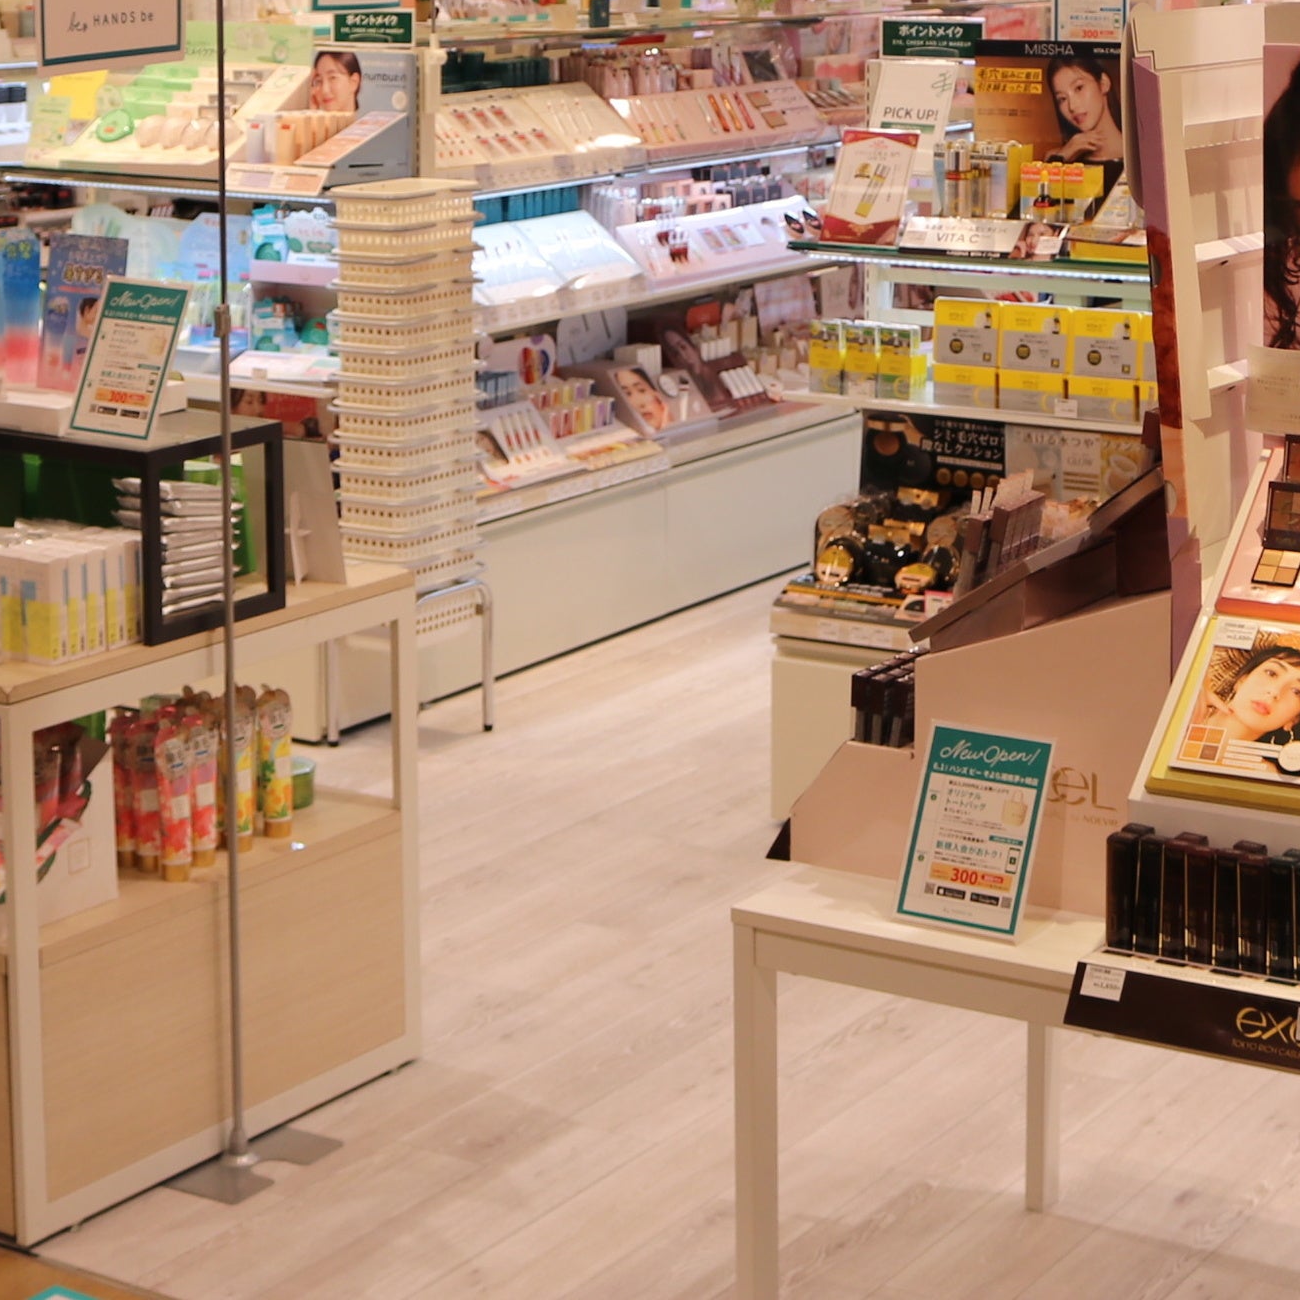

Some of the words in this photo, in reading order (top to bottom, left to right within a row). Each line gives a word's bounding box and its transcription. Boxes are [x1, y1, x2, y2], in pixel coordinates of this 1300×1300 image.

[92, 11, 137, 27] HANDS
[140, 11, 155, 23] be
[898, 23, 964, 39] ポイントメイク
[1082, 29, 1099, 39] 300
[1024, 43, 1075, 57] MISSHA
[883, 106, 914, 120] PICK
[915, 108, 939, 121] UP!
[935, 231, 966, 244] VITA
[968, 231, 980, 244] C
[939, 739, 985, 761] New
[949, 867, 979, 886] 300
